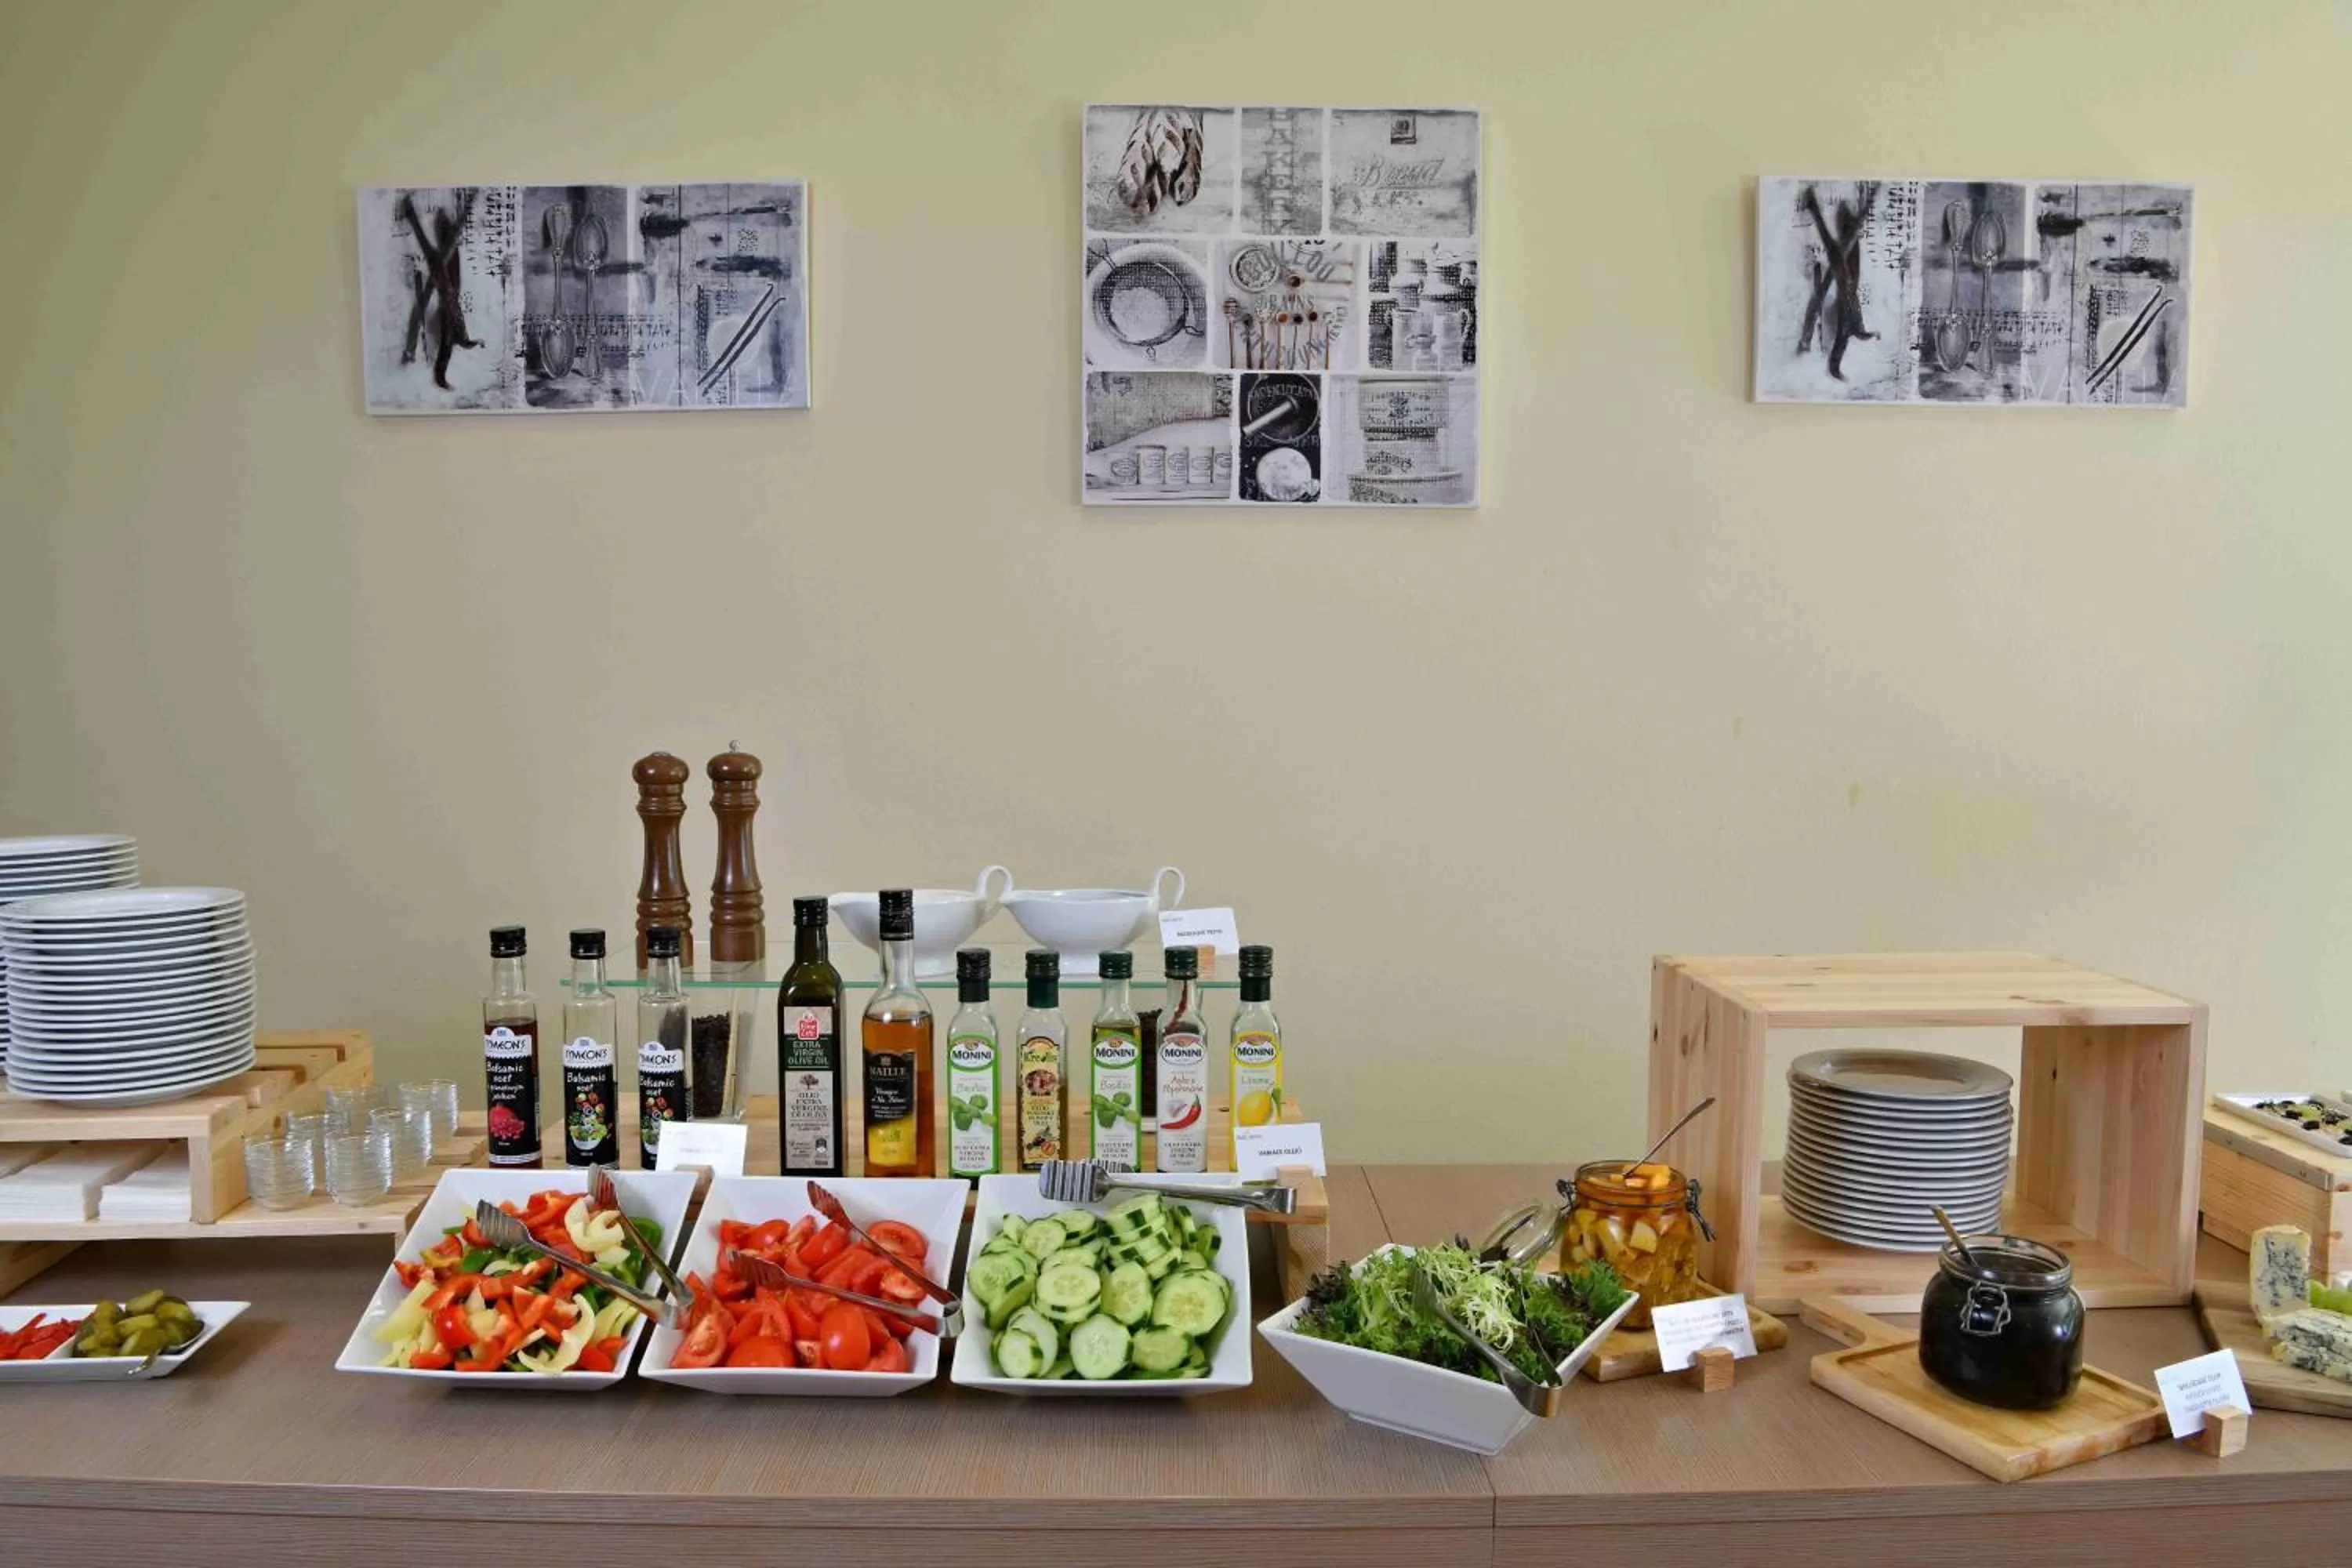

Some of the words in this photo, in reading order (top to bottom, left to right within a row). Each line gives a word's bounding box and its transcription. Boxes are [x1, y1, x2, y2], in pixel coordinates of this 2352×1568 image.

[952, 1051, 992, 1059] MONINI
[1096, 1047, 1135, 1057] MONINI
[1237, 1047, 1274, 1056] MONINI
[788, 1056, 813, 1065] OLIVE
[815, 1056, 829, 1065] OIL
